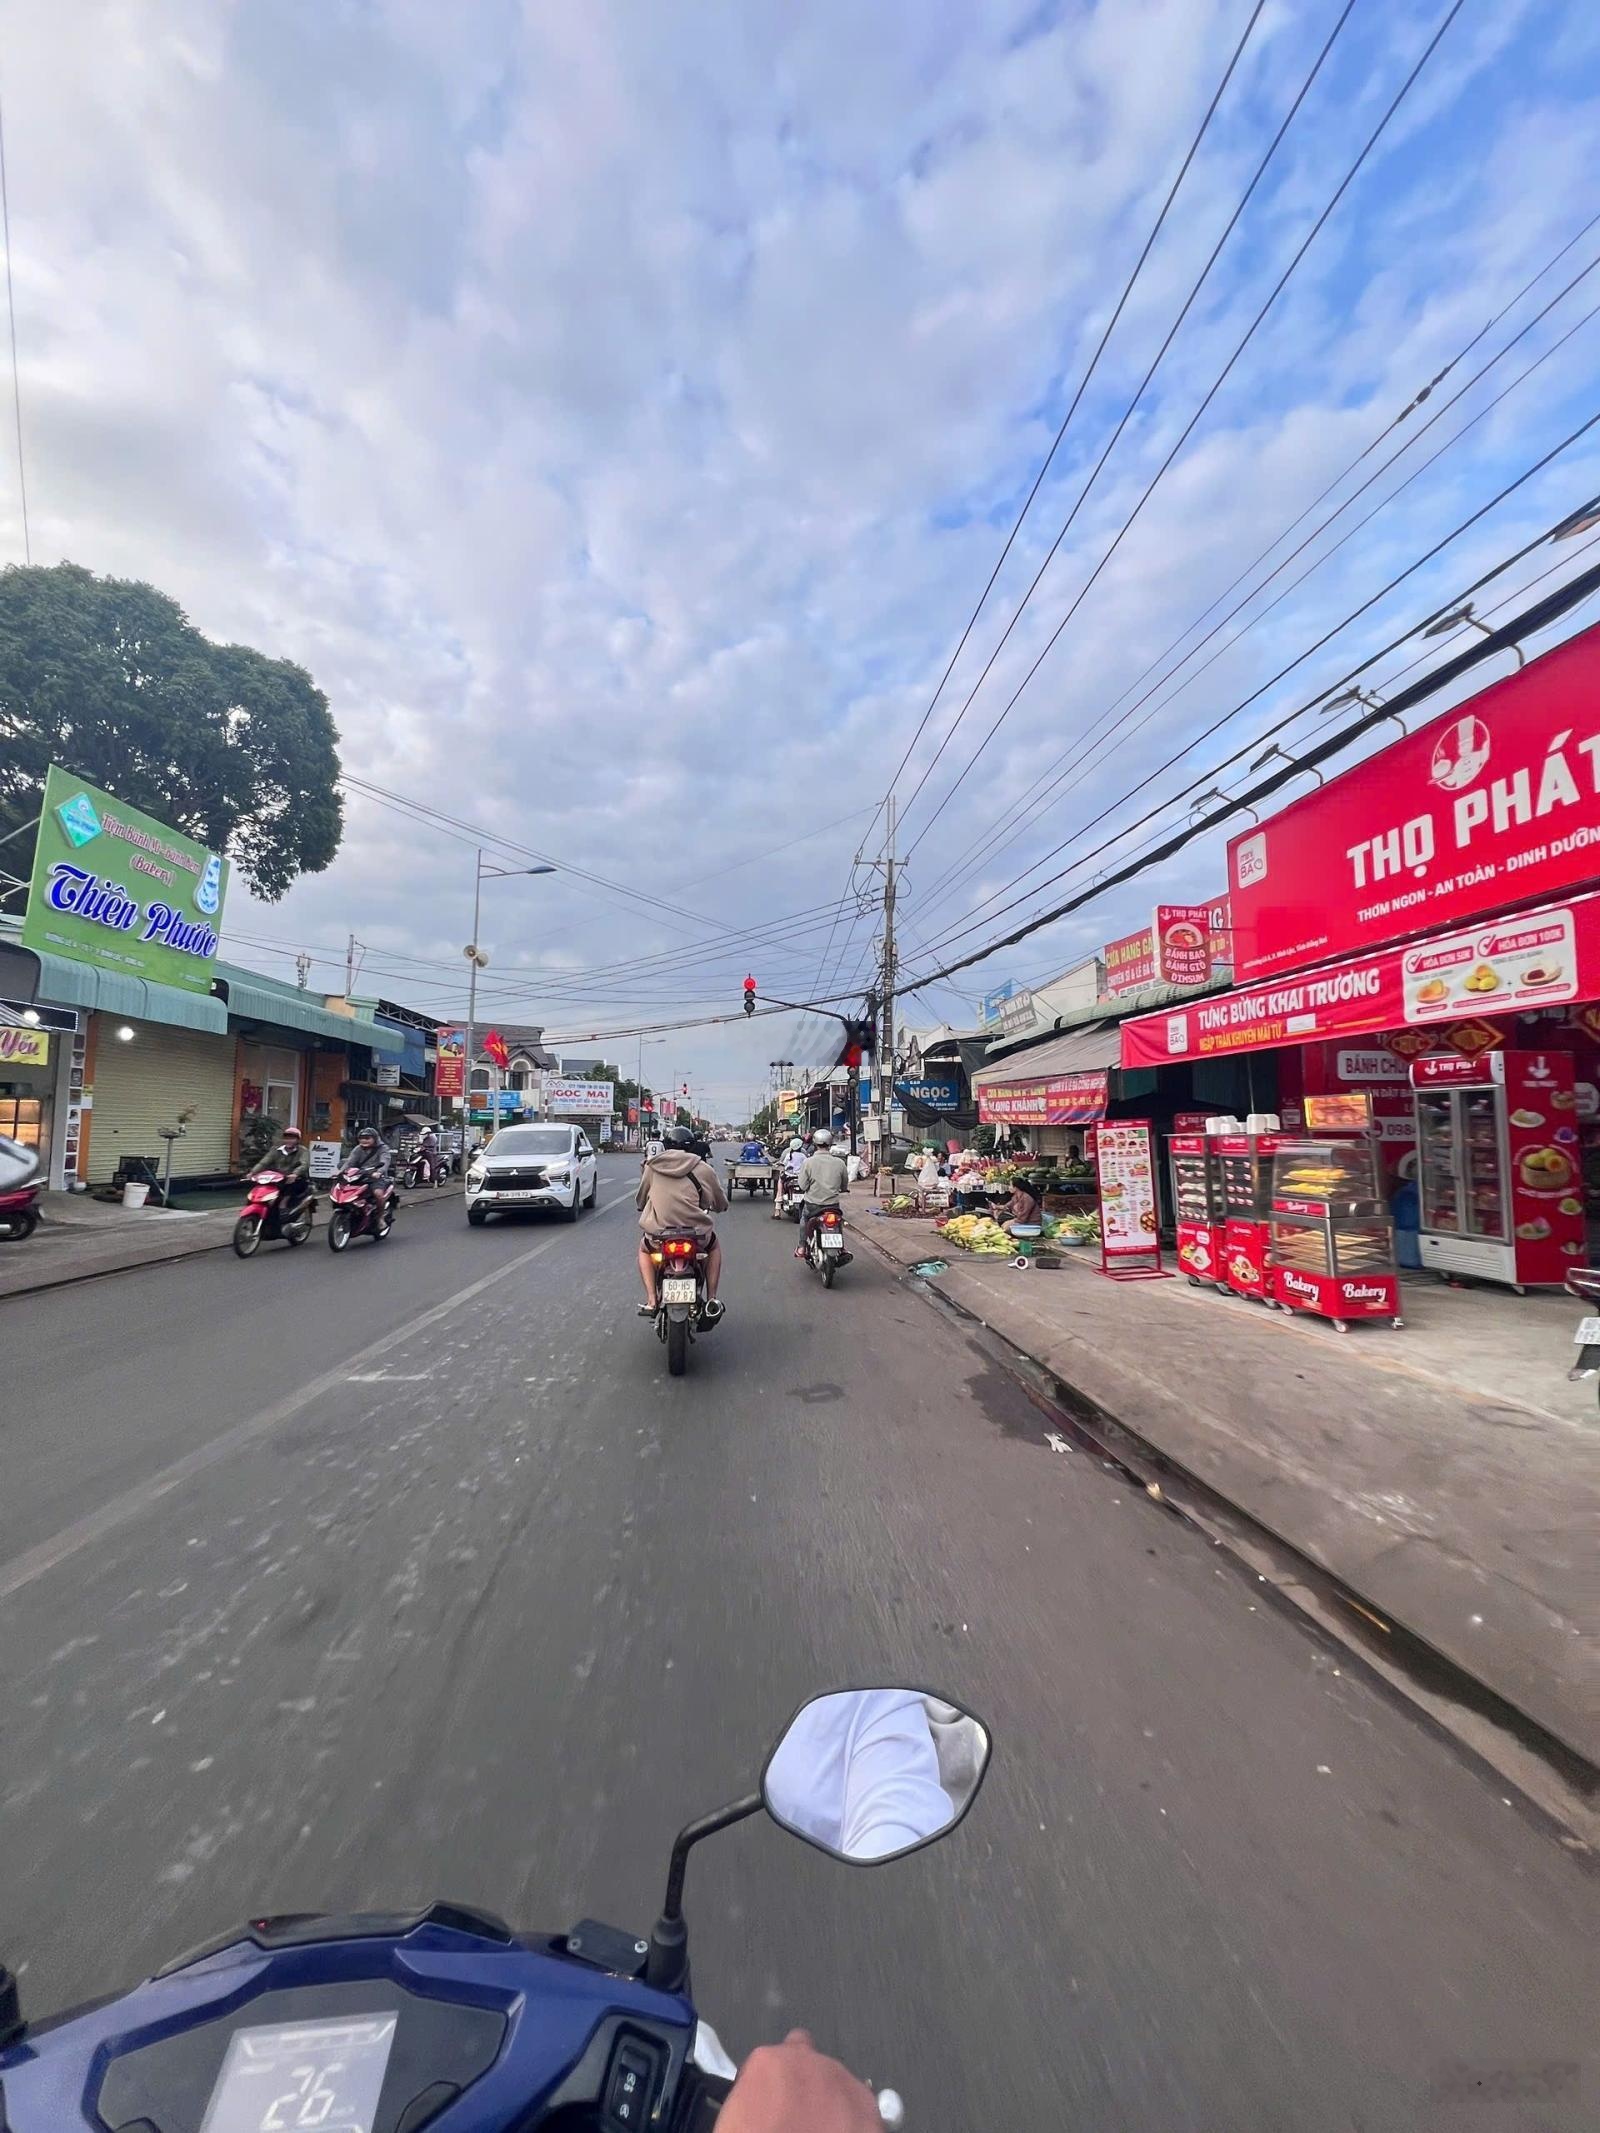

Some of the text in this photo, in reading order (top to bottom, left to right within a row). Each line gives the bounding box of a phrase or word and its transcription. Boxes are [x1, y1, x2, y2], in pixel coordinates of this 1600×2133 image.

[1346, 728, 1600, 889] THỌ PHÁT
[1357, 904, 1390, 923] THƠM
[1391, 888, 1426, 911] NGON
[1435, 878, 1454, 897] AN
[1455, 863, 1496, 889] TOÀN
[1507, 845, 1547, 872] DINH
[50, 862, 138, 930] Thiên
[142, 902, 217, 957] Phước
[1172, 908, 1207, 920] THỌ PHÁT
[1165, 948, 1206, 960] BÁNH BAO
[1165, 959, 1189, 972] BÁNH
[1171, 972, 1205, 984] DIMSUM
[1230, 990, 1265, 1024] BỪNG
[1268, 985, 1304, 1016] KHAI
[1345, 1054, 1377, 1073] BÁNH
[587, 1090, 608, 1098] MAI
[651, 1145, 657, 1156] 9
[1284, 1271, 1319, 1302] Bakery
[1342, 1283, 1387, 1302] Bakery
[260, 2062, 345, 2131] 26
